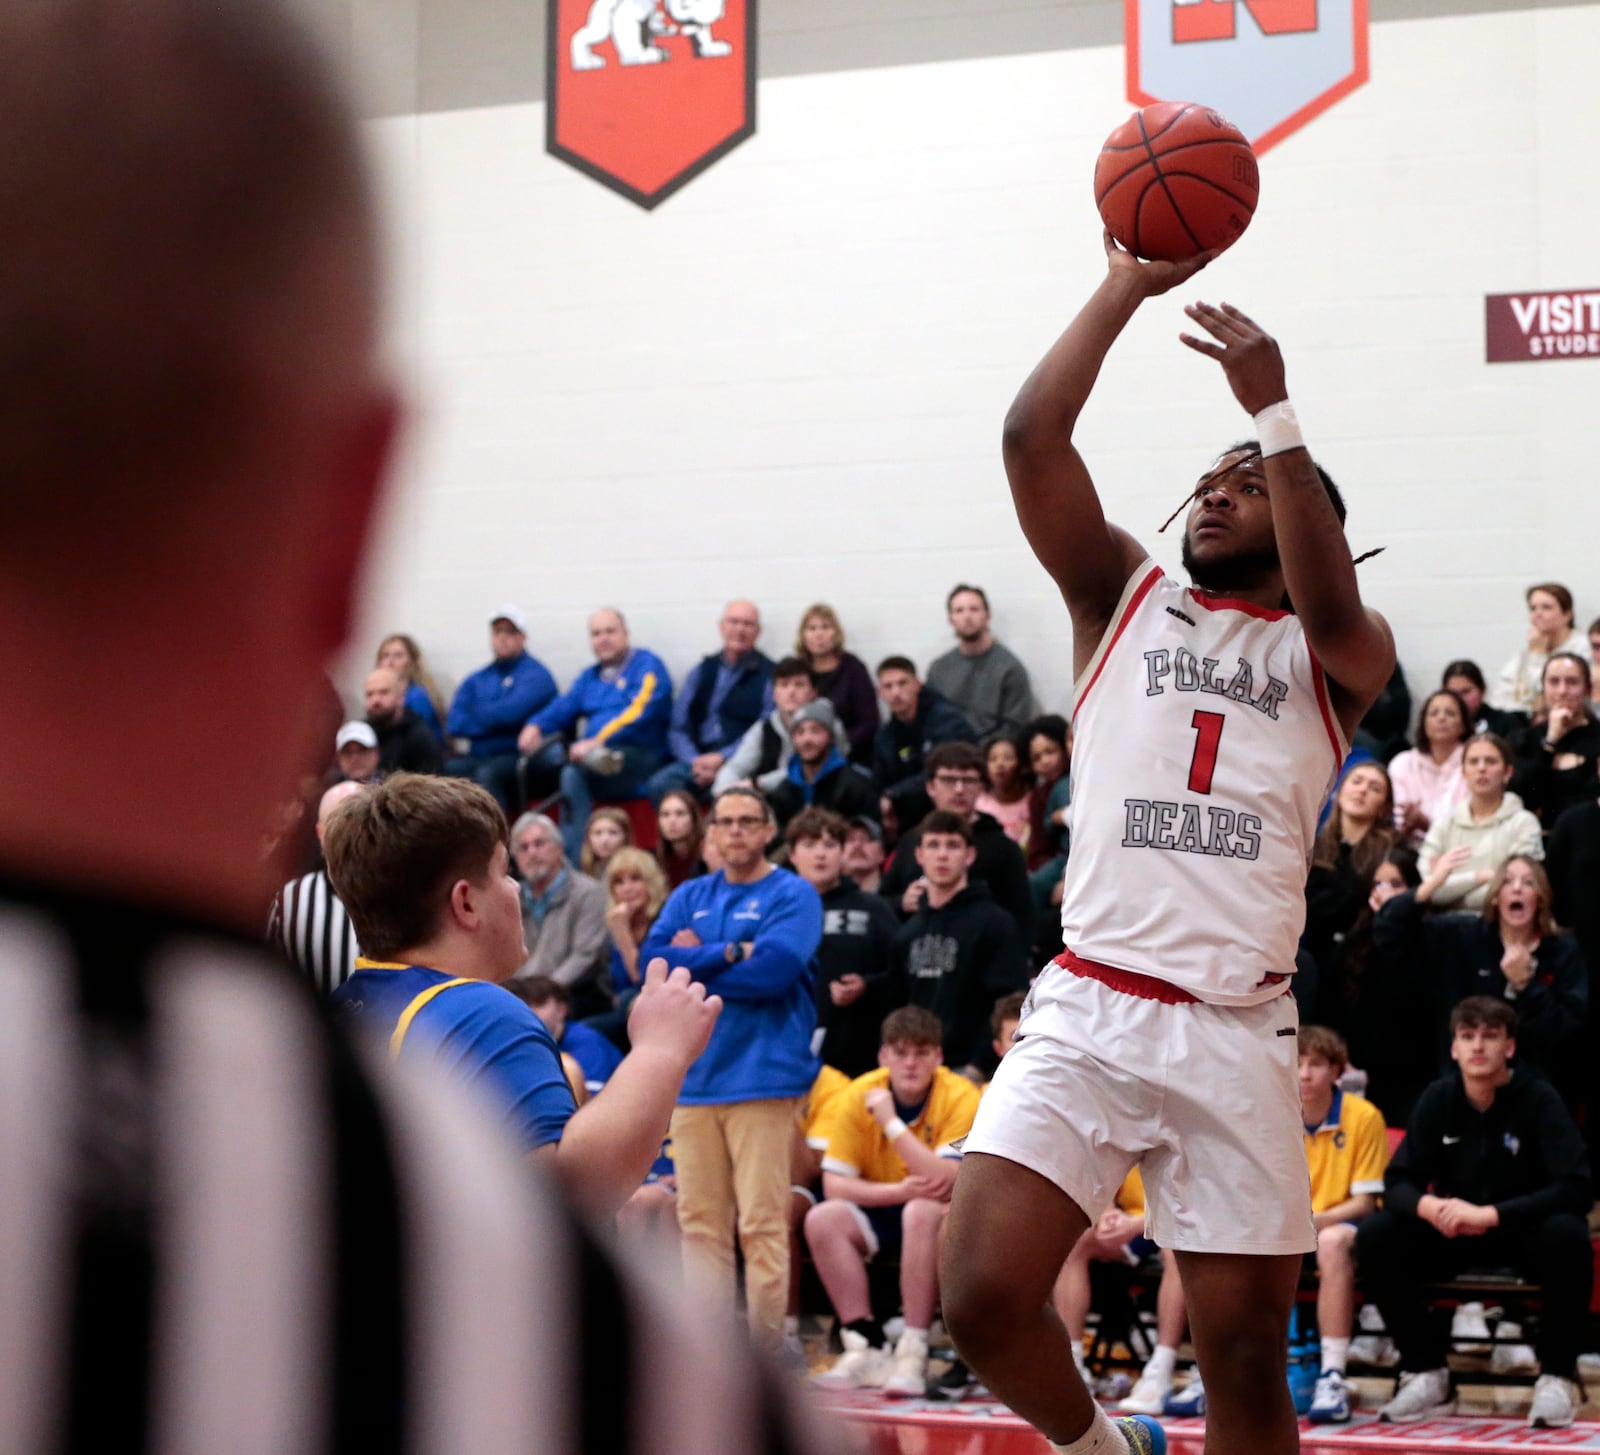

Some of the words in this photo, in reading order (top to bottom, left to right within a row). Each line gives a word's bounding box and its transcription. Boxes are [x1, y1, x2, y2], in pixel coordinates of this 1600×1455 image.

[1144, 646, 1288, 721] POLAR
[1187, 709, 1225, 795] 1
[1122, 798, 1262, 861] BEARS
